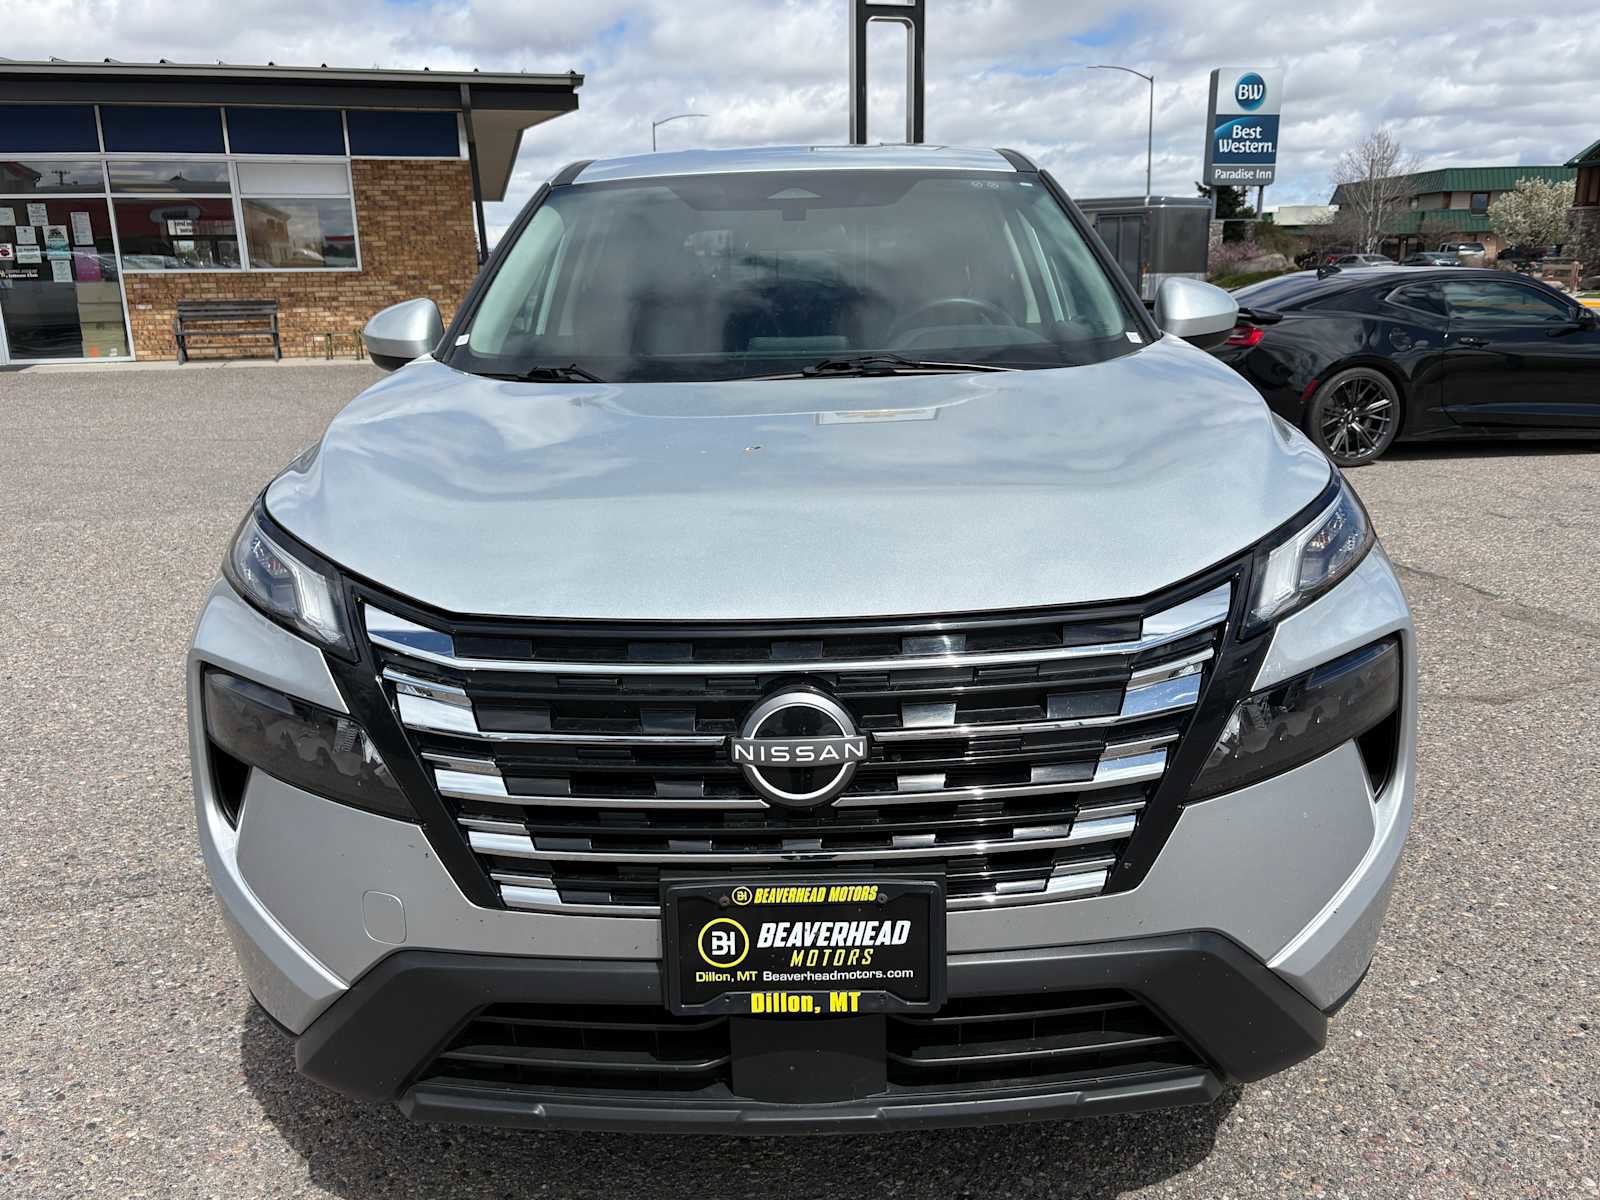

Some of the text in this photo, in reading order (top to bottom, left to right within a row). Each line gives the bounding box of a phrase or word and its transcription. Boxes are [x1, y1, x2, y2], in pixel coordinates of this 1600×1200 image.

[1238, 84, 1264, 100] BW
[1232, 124, 1263, 139] Best
[1214, 168, 1272, 180] Paradise Inn
[734, 741, 864, 762] NISSAN
[753, 885, 879, 904] BEAVERHEAD MOTORS
[756, 920, 911, 948] BEAVERHEAD
[789, 948, 874, 968] MOTORS
[695, 969, 914, 983] Dillon, MT Beaverheadmotors.com
[750, 991, 861, 1014] Dillon, MT
